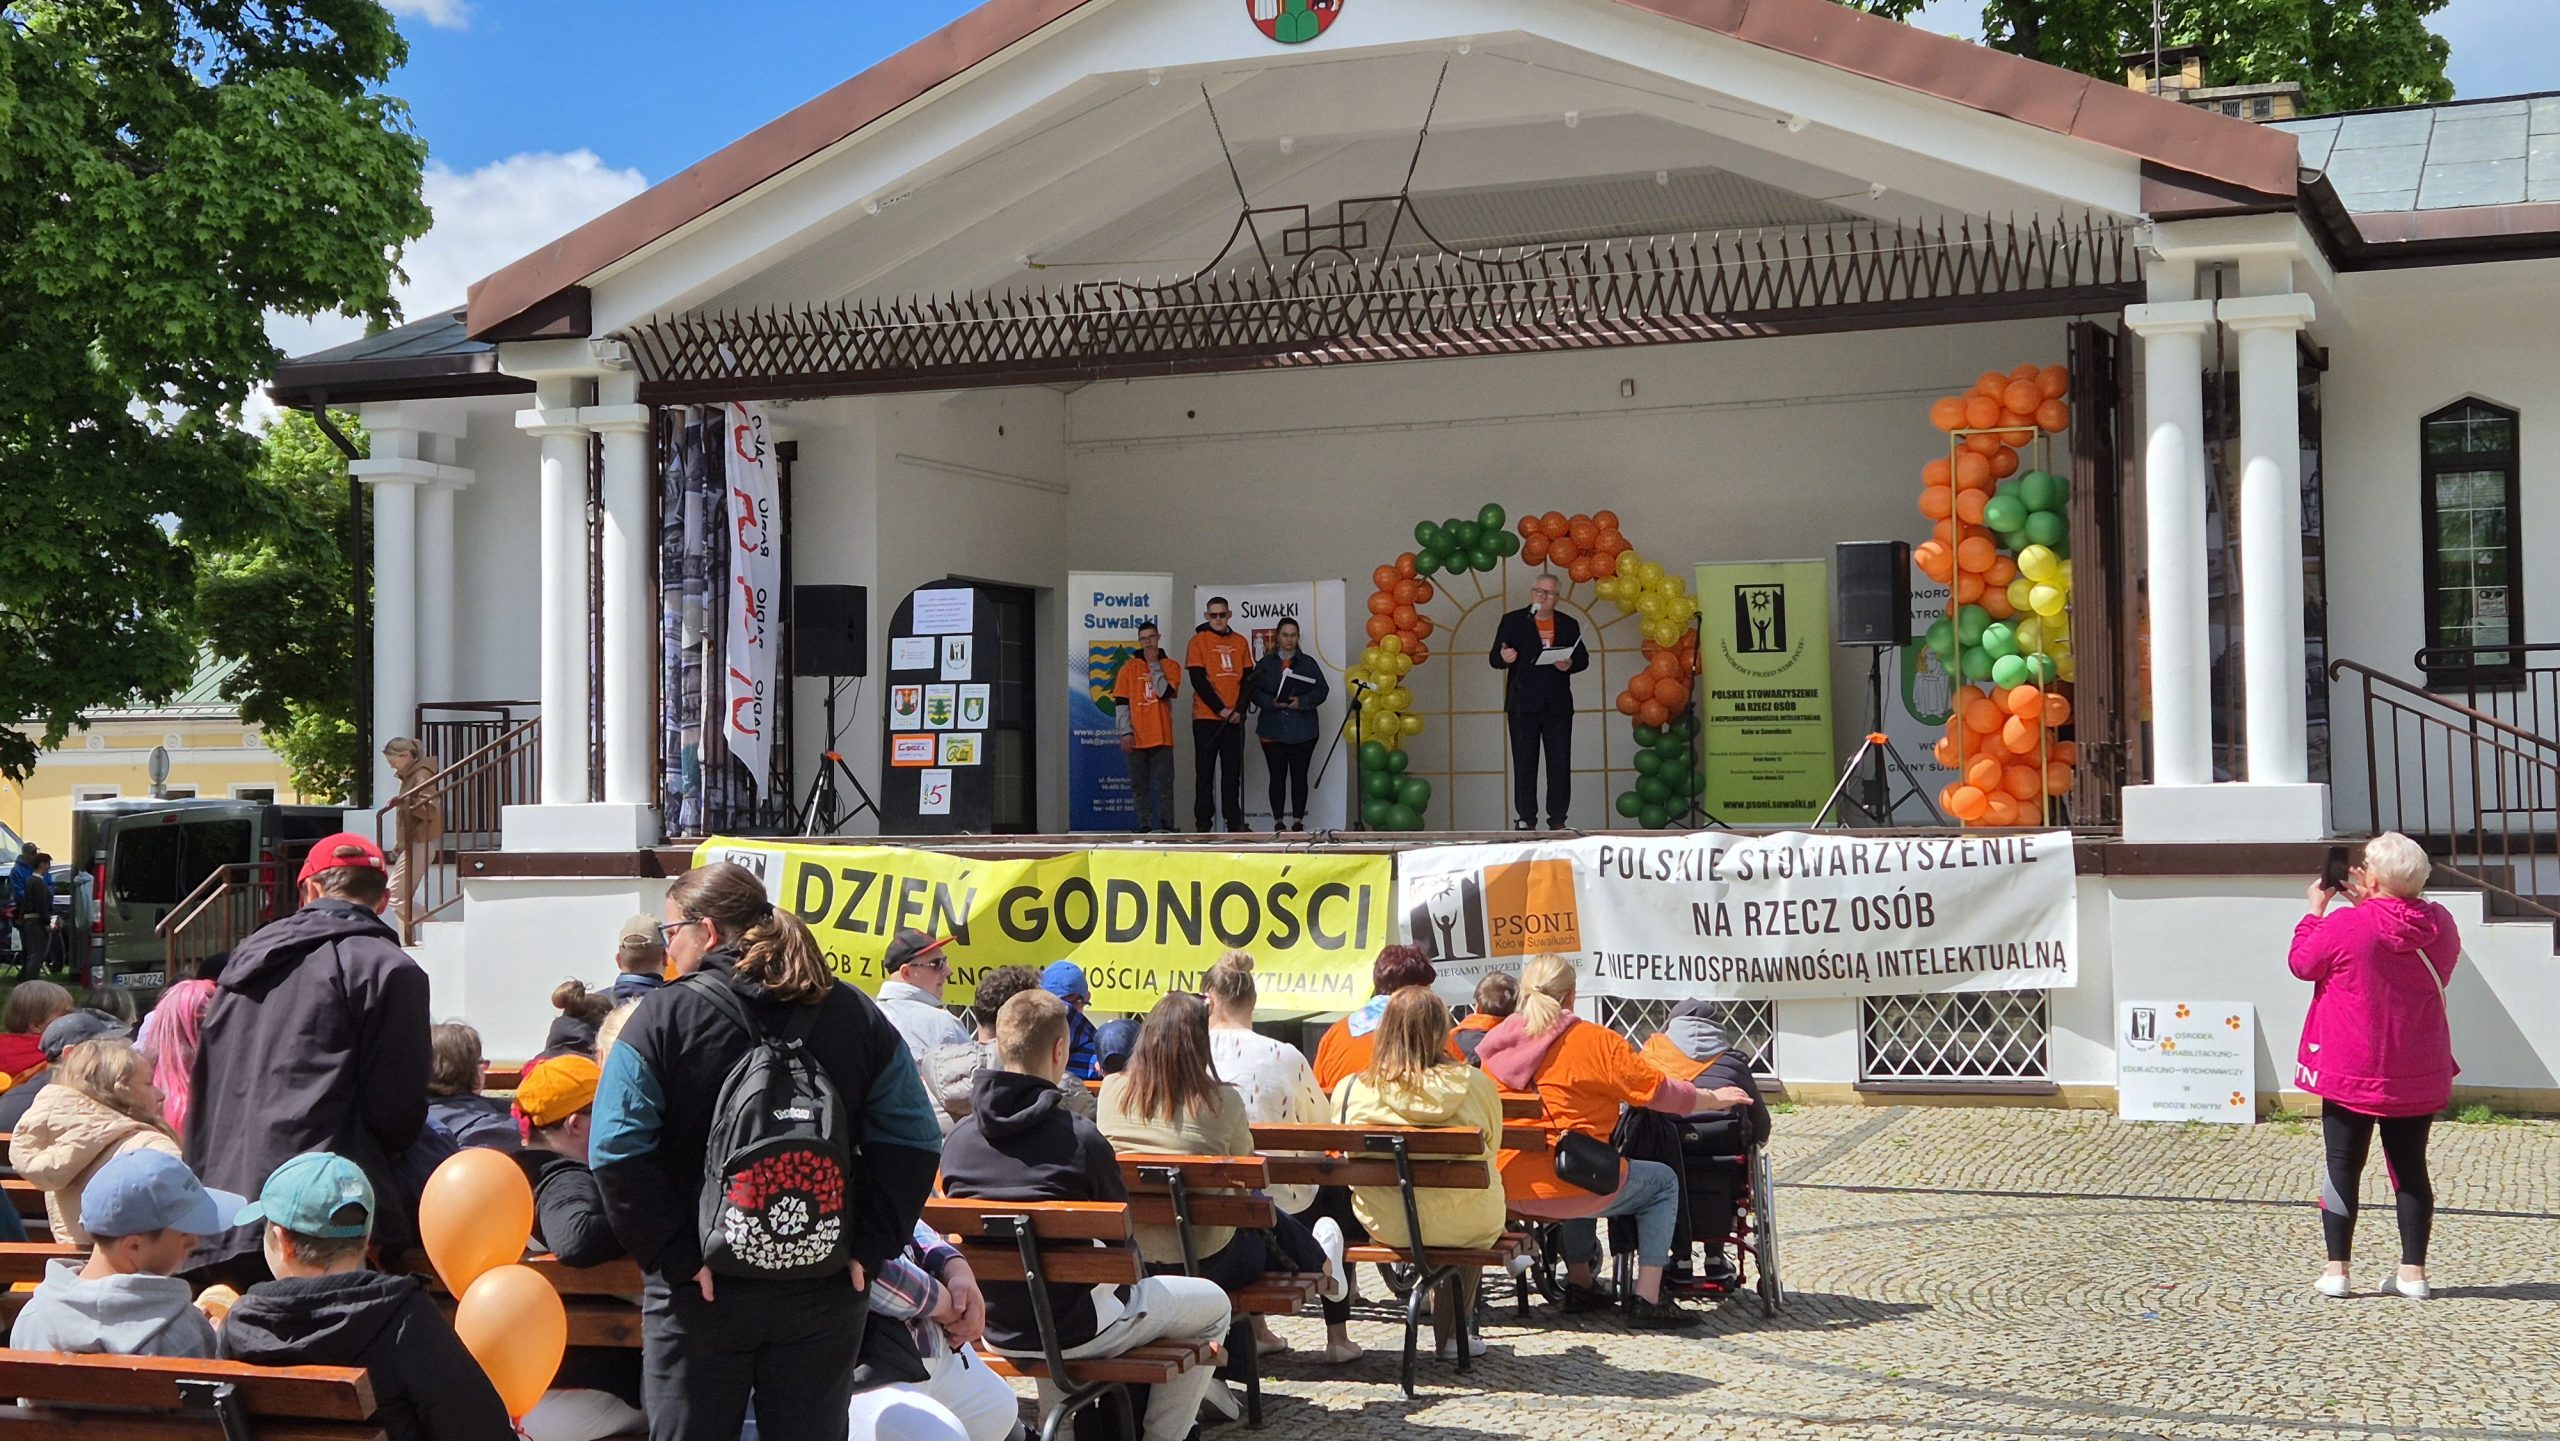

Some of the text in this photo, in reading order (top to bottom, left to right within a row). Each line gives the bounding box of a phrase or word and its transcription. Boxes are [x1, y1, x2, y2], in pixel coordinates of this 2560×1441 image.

[1093, 592, 1150, 607] Powiat
[1911, 589, 1950, 599] NORO
[1241, 601, 1299, 619] SUWAŁKI
[1711, 688, 1819, 699] POLSKIE STOWARZYSZENIE
[1735, 700, 1797, 711] NA RZECZ OSÓB
[1888, 763, 1926, 773] GNY
[1599, 837, 2038, 882] POLSKIE STOWARZYSZENIE
[795, 862, 1371, 950] DZIEŃ GODNOŚCI
[1692, 886, 1935, 937] NA RZECZ OSÓB
[1492, 912, 1575, 937] PSONI
[1518, 940, 1526, 949] w
[1593, 940, 2067, 983] Z NIEPEŁNOSPRAWNOŚCIĄ INTELEKTUALNĄ
[828, 946, 851, 974] ÓB
[860, 957, 873, 978] Z
[1169, 969, 1354, 996] INTUALNĄ
[1435, 965, 1482, 978] IERAMY
[2175, 1032, 2214, 1040] OŚRODEK
